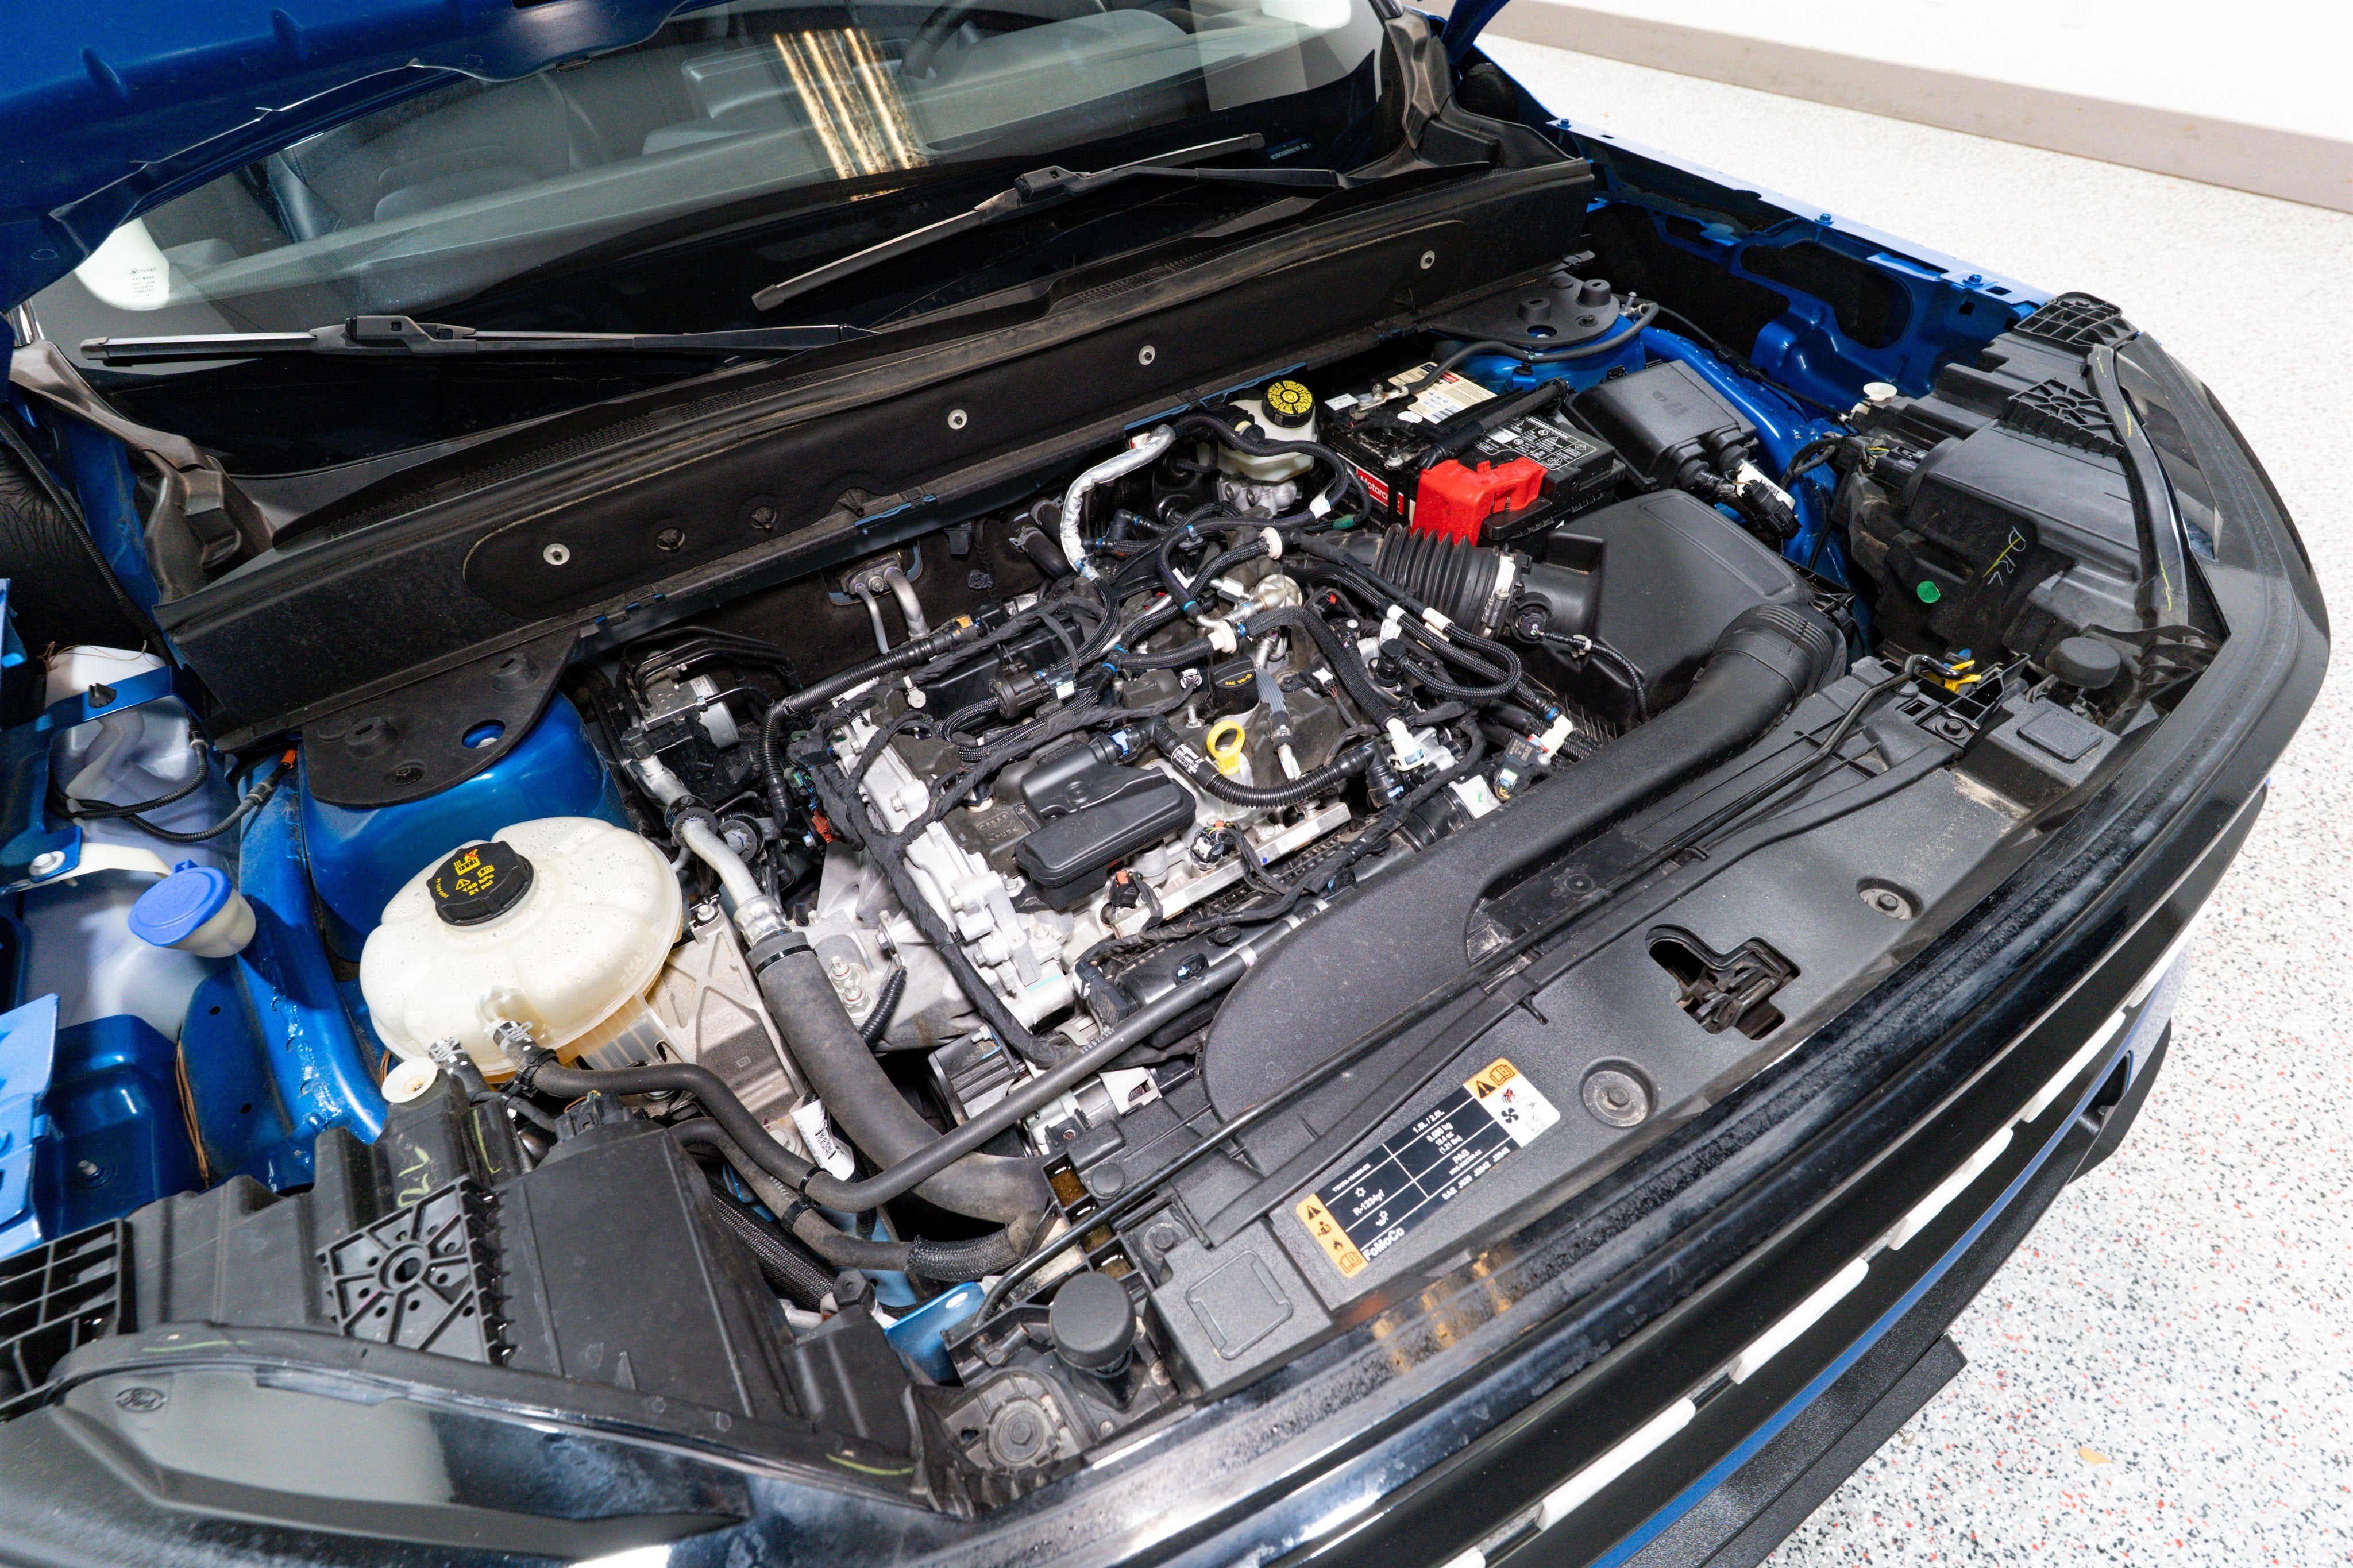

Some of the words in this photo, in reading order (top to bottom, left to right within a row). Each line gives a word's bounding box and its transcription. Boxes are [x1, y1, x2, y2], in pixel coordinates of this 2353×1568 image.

[462, 880, 478, 893] 145
[468, 887, 480, 896] 21
[480, 879, 493, 890] psi
[1452, 1149, 1470, 1164] PAG
[1441, 1186, 1458, 1200] SAE
[1352, 1189, 1385, 1216] R-1234yf
[1361, 1227, 1405, 1262] FoMoCo
